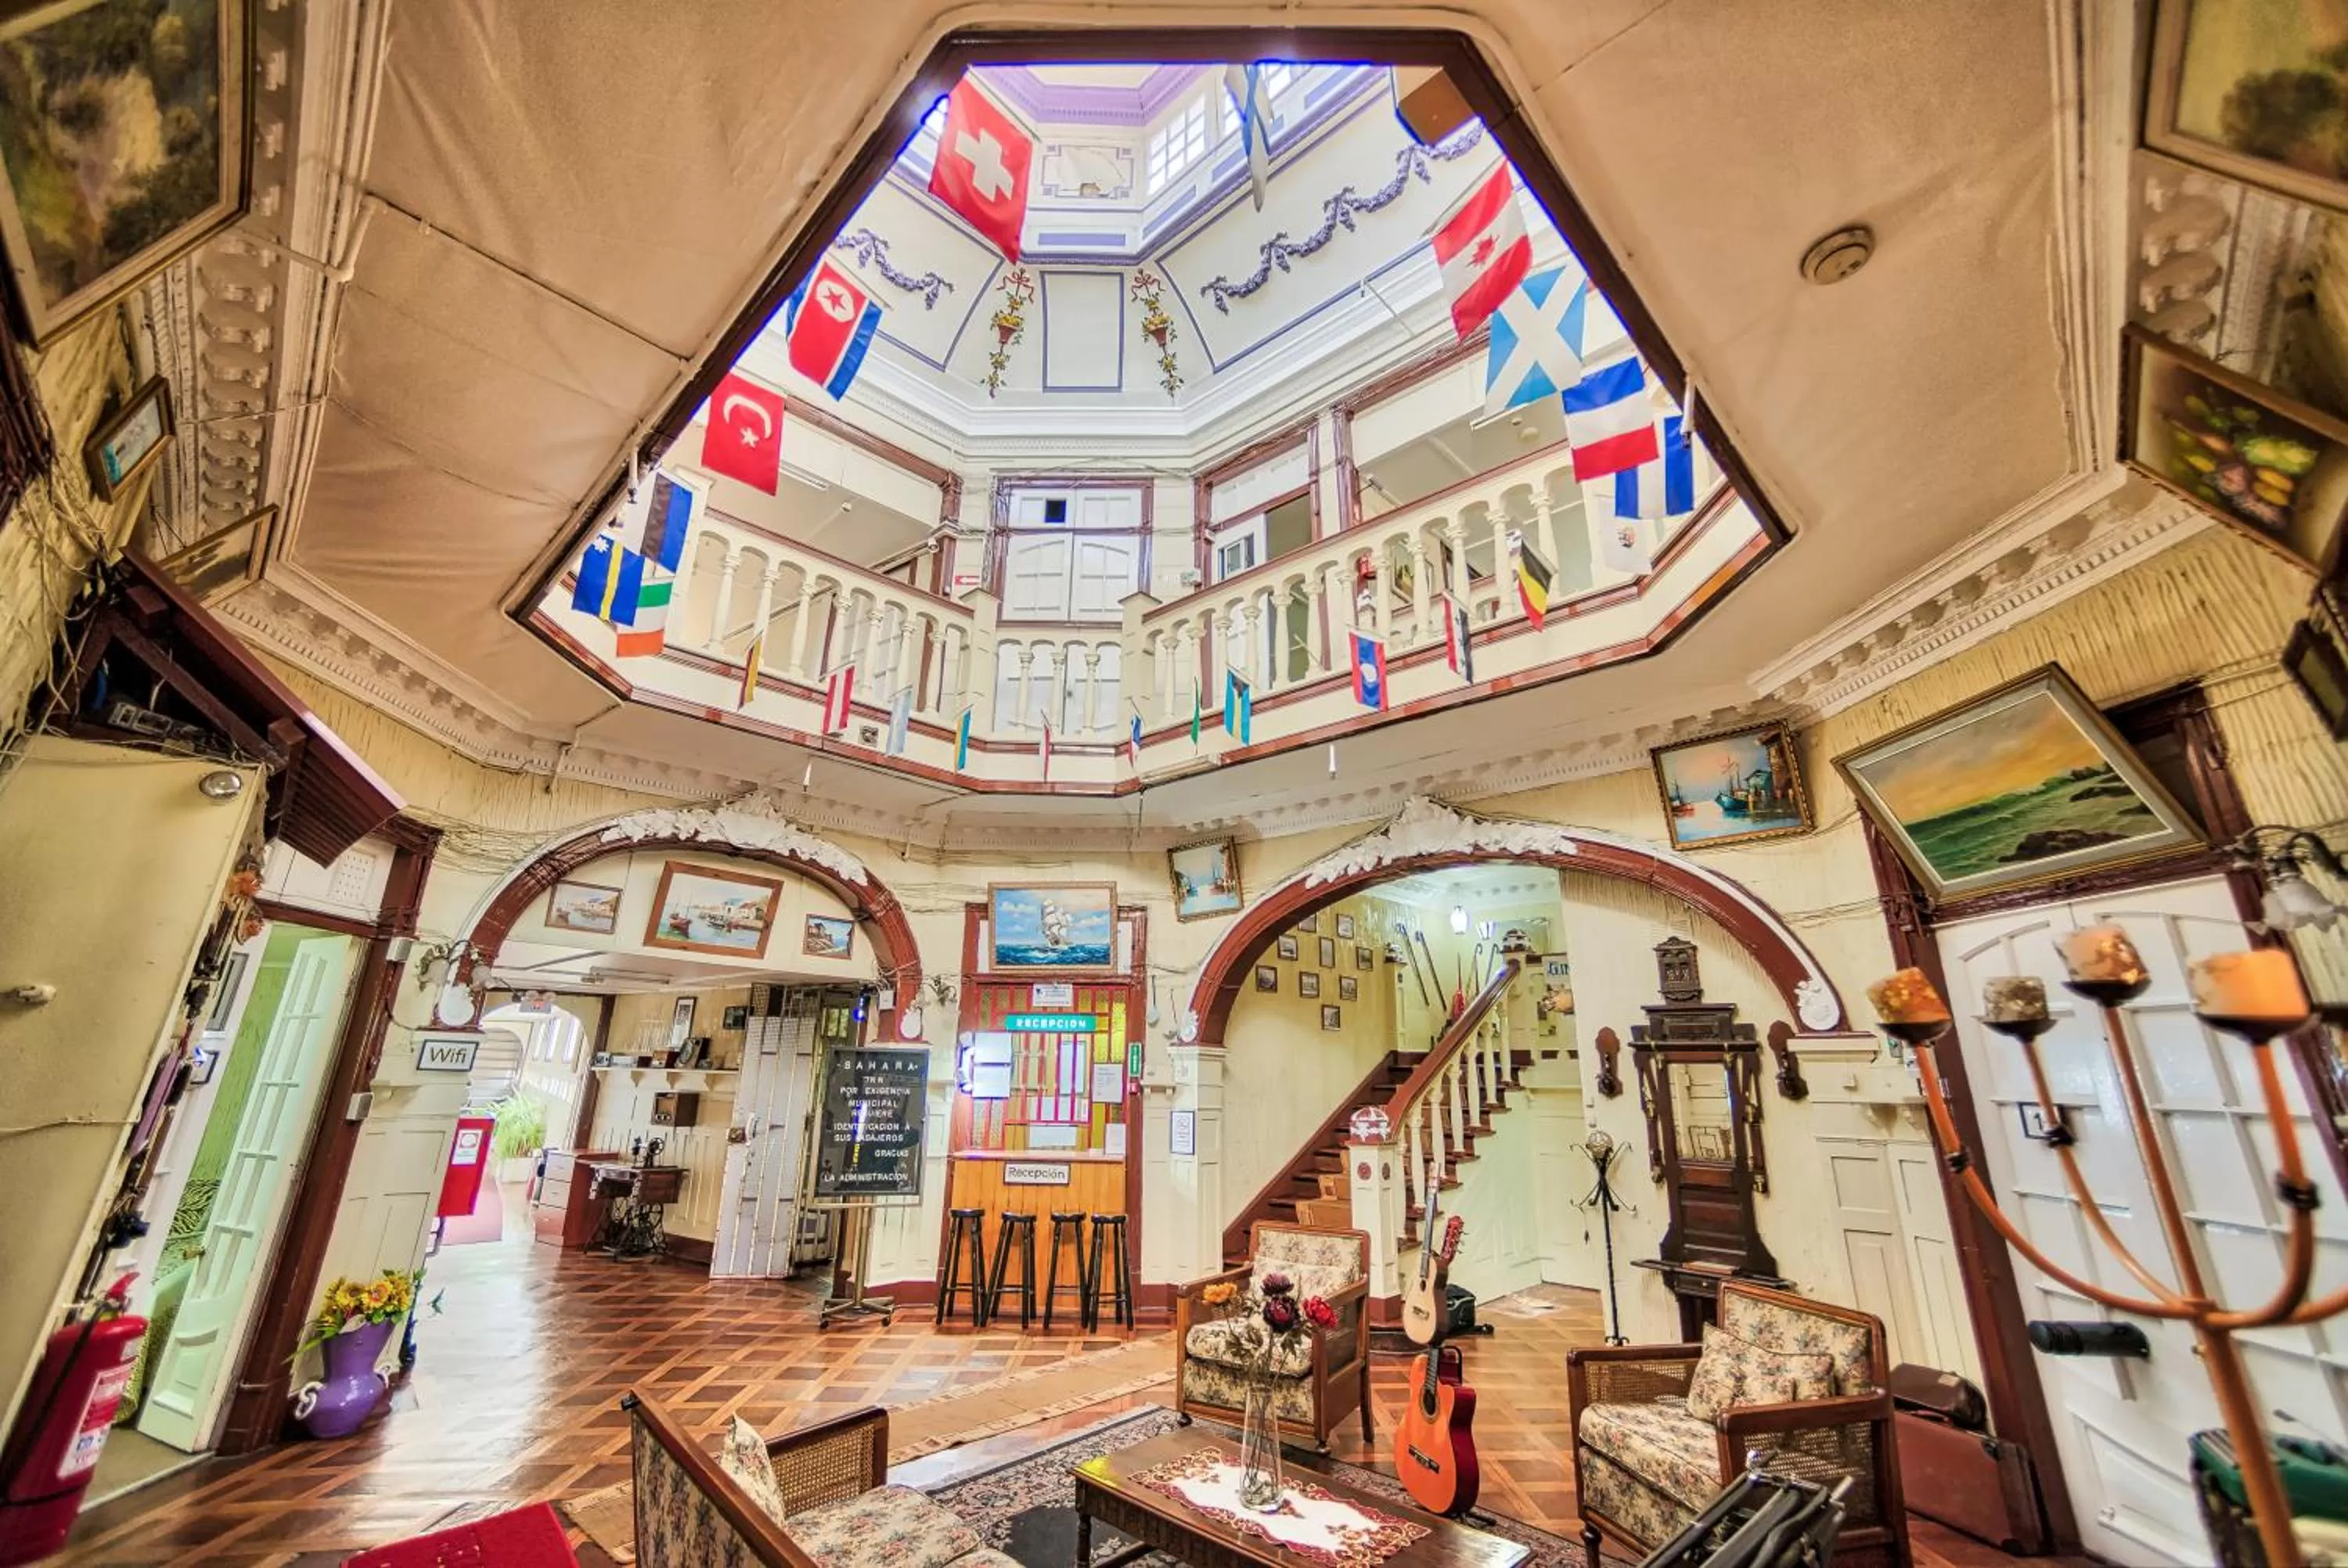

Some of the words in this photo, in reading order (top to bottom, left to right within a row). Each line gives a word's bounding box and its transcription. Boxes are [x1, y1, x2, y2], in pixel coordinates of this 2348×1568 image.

[1016, 1018, 1086, 1028] RECEPCION
[430, 1047, 467, 1064] Wifi
[840, 1087, 858, 1095] POR
[865, 1087, 910, 1095] EXIGENCIA
[848, 1099, 898, 1108] MUNICIPAL
[874, 1149, 909, 1157] GRACIAS
[824, 1174, 835, 1182] LA
[1008, 1167, 1065, 1180] Recepción
